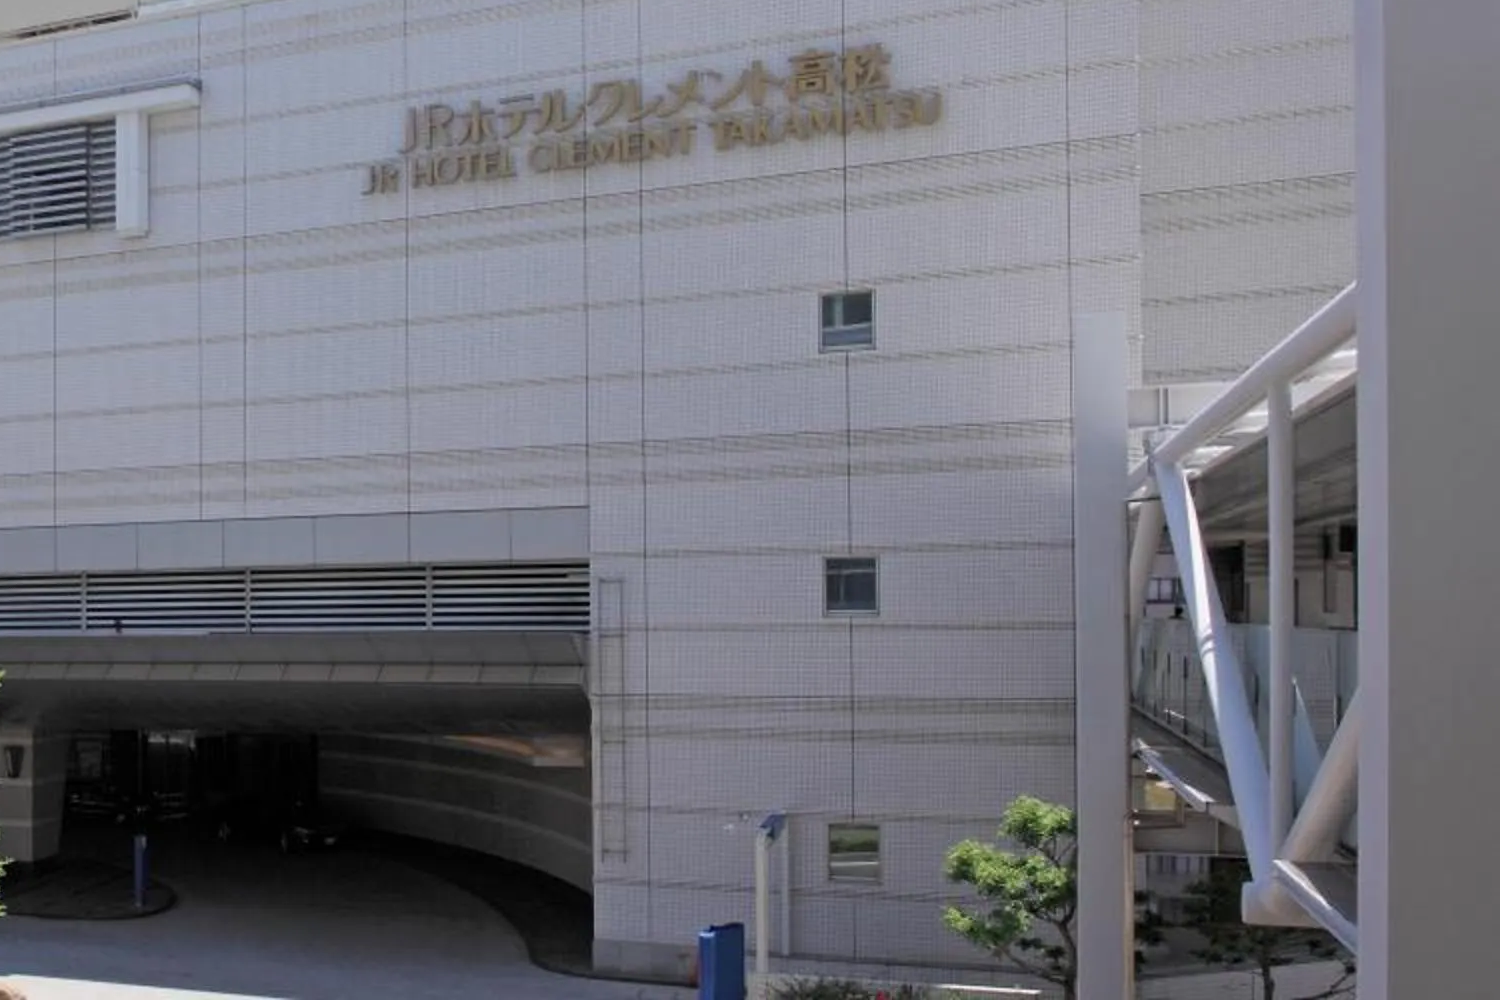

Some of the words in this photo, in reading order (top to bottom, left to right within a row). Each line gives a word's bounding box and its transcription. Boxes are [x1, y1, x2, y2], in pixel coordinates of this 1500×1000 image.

[361, 165, 399, 195] JR
[411, 149, 516, 188] HOTEL
[527, 124, 698, 173] CLEMENT
[710, 91, 943, 151] TAKAMATSU
